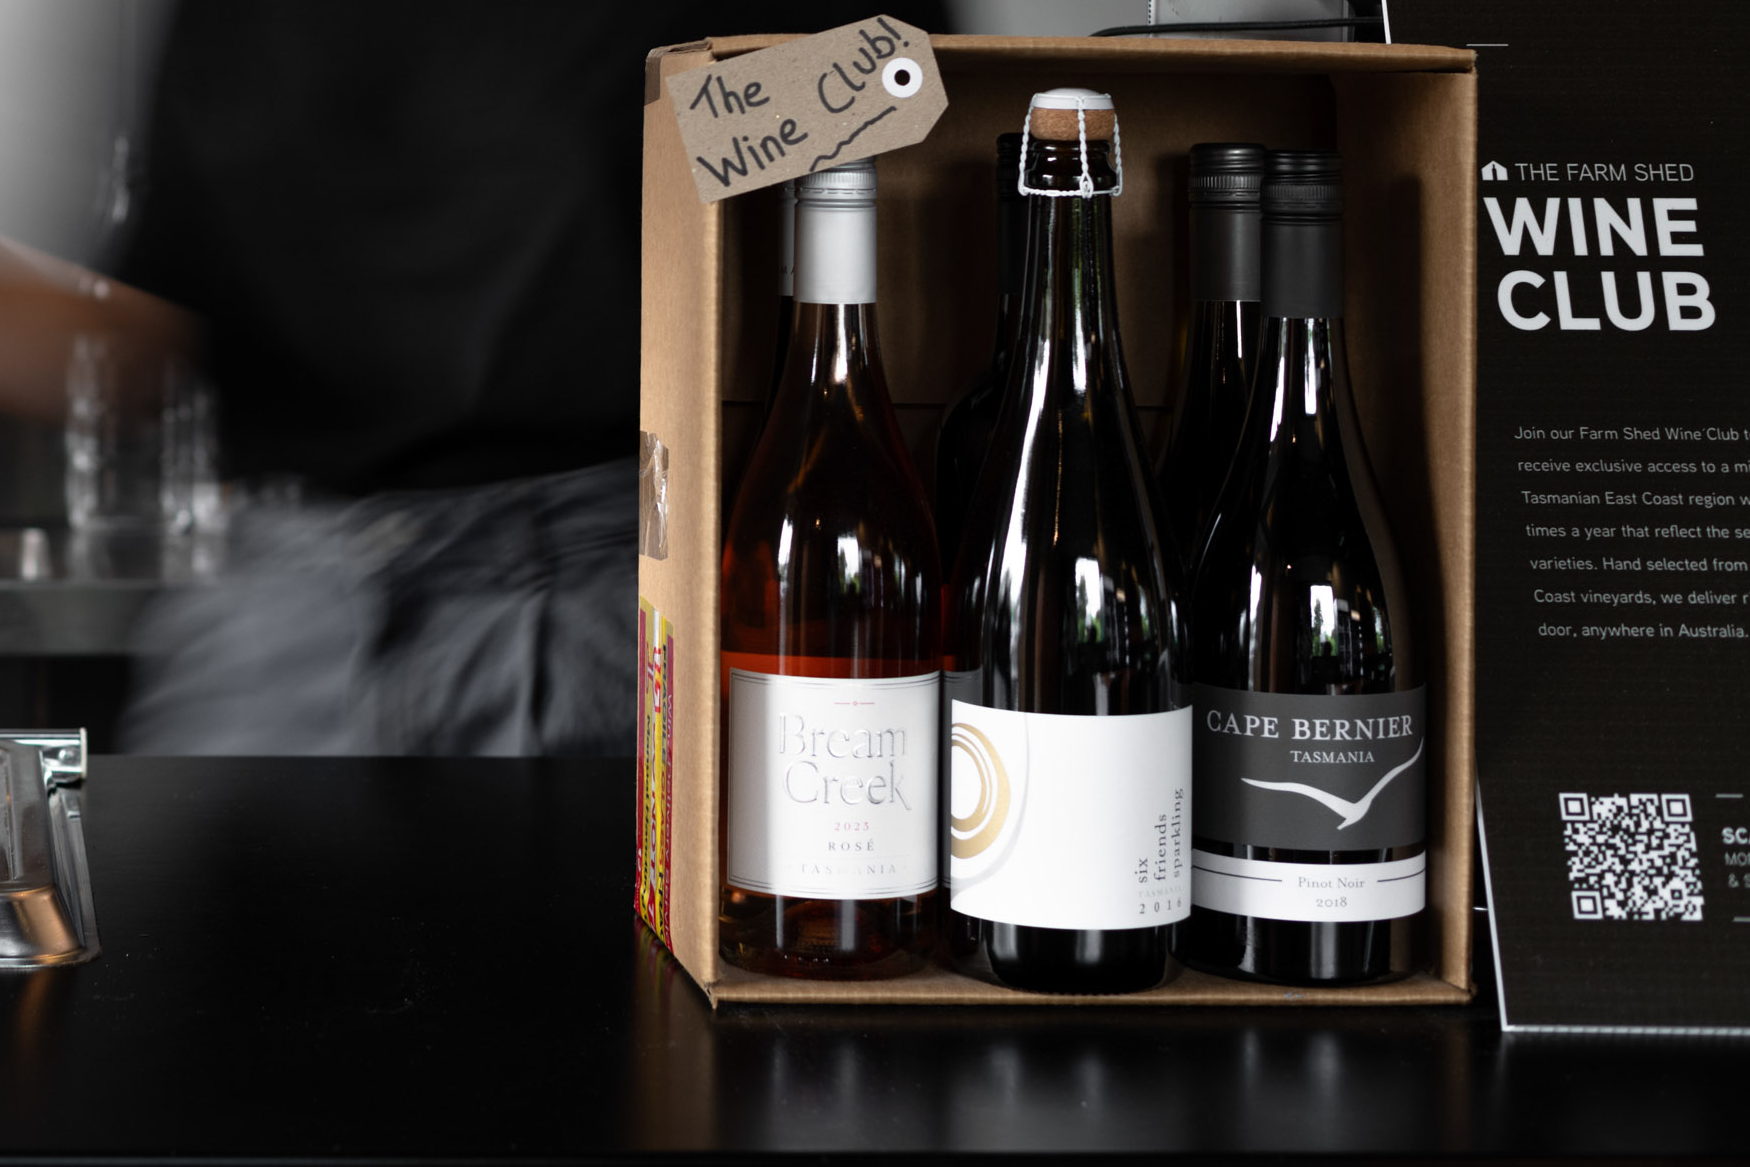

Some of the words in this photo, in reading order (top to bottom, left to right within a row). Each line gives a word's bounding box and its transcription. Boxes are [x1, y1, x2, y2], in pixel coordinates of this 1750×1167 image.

[690, 74, 770, 118] The
[696, 118, 808, 187] Wine
[818, 17, 910, 114] Club!
[1514, 164, 1560, 181] THE
[1566, 164, 1627, 181] FARM
[1634, 164, 1694, 181] SHED
[1483, 197, 1704, 256] WINE
[1498, 270, 1716, 331] CLUB
[1514, 426, 1546, 440] Join
[1550, 429, 1574, 439] our
[1580, 427, 1618, 440] Farm
[1623, 427, 1660, 440] Shed
[1664, 427, 1702, 440] Wine
[1706, 428, 1739, 440] Club
[1518, 459, 1570, 472] receive
[1575, 459, 1642, 472] exclusive
[1647, 462, 1697, 472] access
[1702, 461, 1715, 472] to
[1720, 462, 1729, 473] a
[1521, 491, 1600, 504] Tasmanian
[1605, 491, 1637, 505] East
[1642, 492, 1683, 505] Coast
[1689, 492, 1734, 508] region
[1526, 524, 1566, 537] times
[1571, 528, 1579, 537] a
[1584, 527, 1616, 540] year
[1621, 525, 1650, 538] that
[1654, 525, 1701, 538] reflect
[1706, 526, 1729, 538] the
[1530, 556, 1598, 570] varieties.
[1603, 557, 1641, 570] Hand
[1646, 558, 1707, 571] selected
[1712, 558, 1748, 571] from
[1534, 589, 1576, 603] Coast
[1580, 590, 1656, 606] vineyards,
[1660, 594, 1683, 604] we
[1688, 591, 1737, 604] deliver
[1538, 622, 1577, 638] door,
[1581, 623, 1655, 640] anywhere
[1659, 623, 1673, 637] in
[1678, 624, 1748, 638] Australia.
[1207, 710, 1279, 738] CAPE
[1291, 715, 1413, 741] BERNIER
[778, 712, 906, 758] Bream
[1290, 750, 1375, 763] TASMANIA
[785, 760, 912, 811] Creek
[1171, 788, 1184, 878] sparkling
[1722, 827, 1750, 844] SC
[828, 838, 874, 851] ROSÉ
[1154, 814, 1167, 881] friends
[1135, 858, 1148, 884] six
[1298, 877, 1333, 888] Pinot
[1337, 877, 1365, 888] Noir
[1316, 896, 1348, 908] 2018
